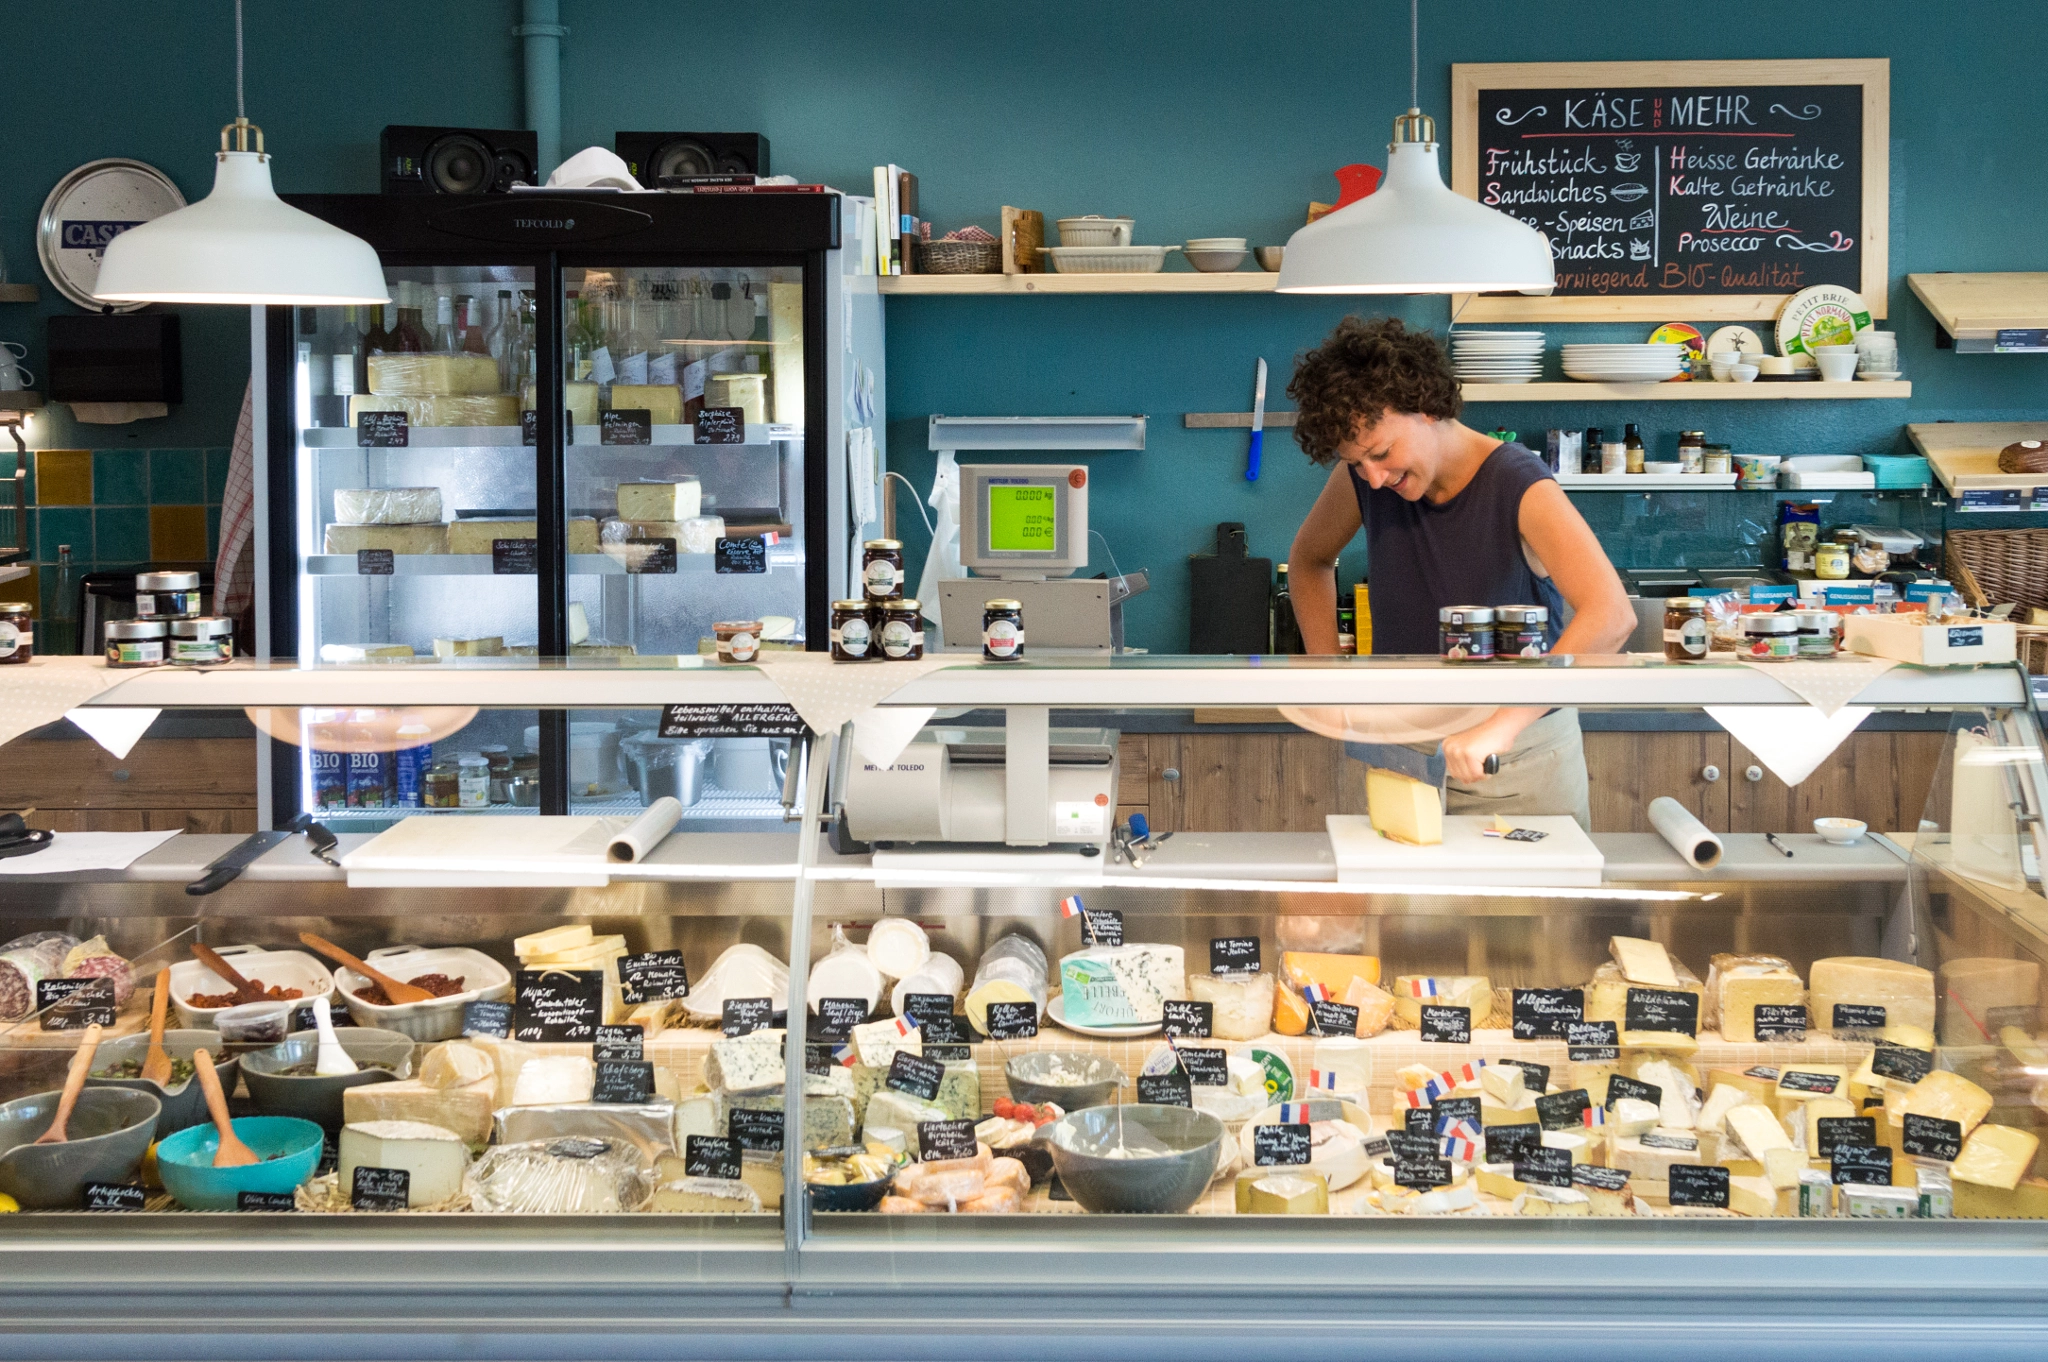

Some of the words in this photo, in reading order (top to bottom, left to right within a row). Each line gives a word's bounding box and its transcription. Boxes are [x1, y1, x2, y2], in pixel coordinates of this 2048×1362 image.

[1565, 92, 1644, 128] KÄSE
[1653, 98, 1662, 128] UND
[1671, 95, 1757, 126] MEHR
[1486, 145, 1607, 176] Frühstück
[1670, 146, 1738, 170] Heisse
[1745, 147, 1844, 170] Getränke
[1484, 177, 1607, 205] Sandwiches
[1669, 174, 1724, 196] Kalte
[1731, 175, 1835, 197] Getränke
[514, 219, 563, 229] TEFCOLD
[1701, 203, 1789, 229] Weine
[1678, 232, 1766, 252] Prosecco
[1792, 295, 1818, 321] PETIT
[1823, 293, 1850, 306] BRIE
[670, 705, 736, 714] Lebensmittel
[740, 704, 797, 714] enthalten
[674, 713, 719, 722] teilweise
[732, 713, 799, 722] ALLERGENE
[665, 725, 688, 735] Bitte
[694, 726, 738, 736] sprechen
[742, 724, 758, 733] Sie
[761, 726, 780, 734] uns
[313, 753, 340, 768] BIO
[350, 753, 379, 768] BIO
